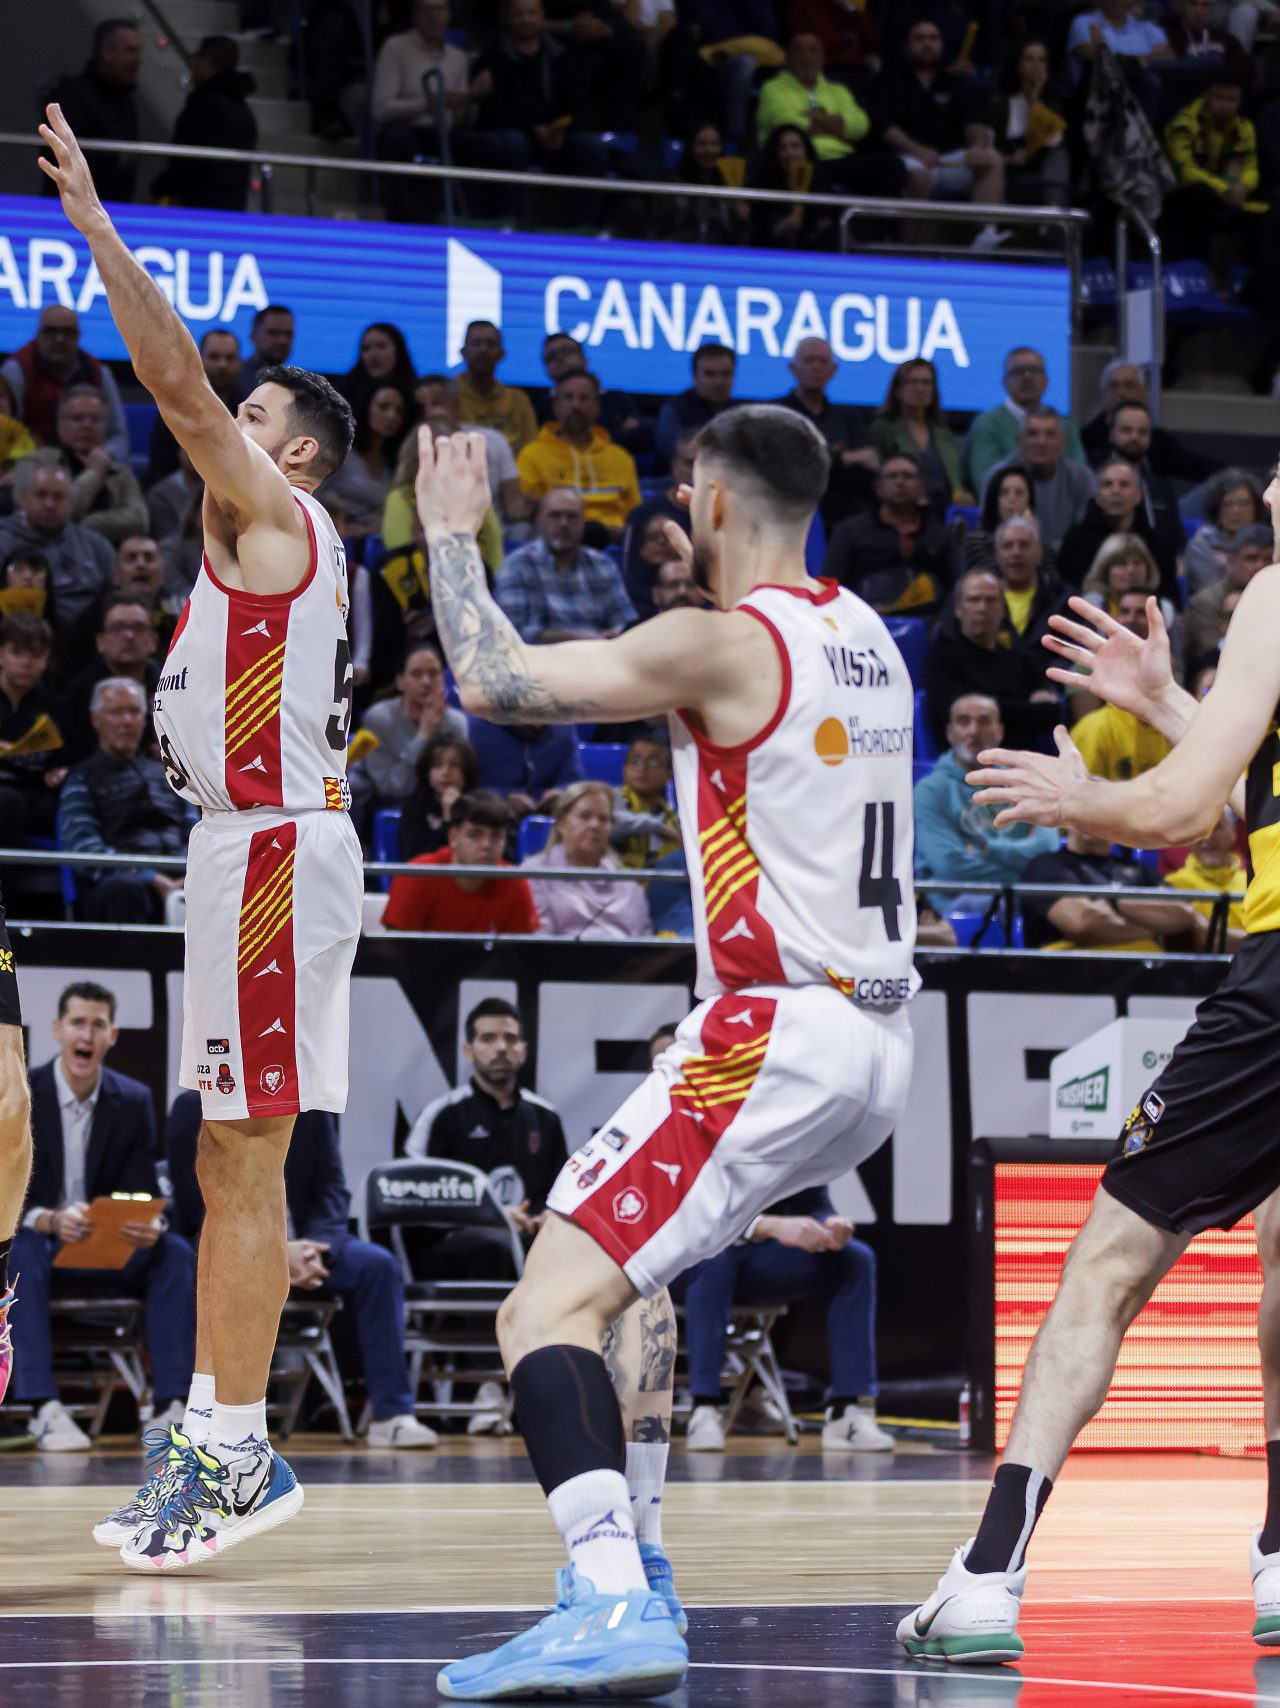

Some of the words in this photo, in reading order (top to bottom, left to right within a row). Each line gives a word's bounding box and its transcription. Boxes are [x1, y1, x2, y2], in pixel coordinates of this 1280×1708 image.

[545, 276, 970, 367] CANARAGUA
[823, 644, 889, 687] YUSTA
[859, 802, 902, 942] 4
[209, 1044, 224, 1053] acb
